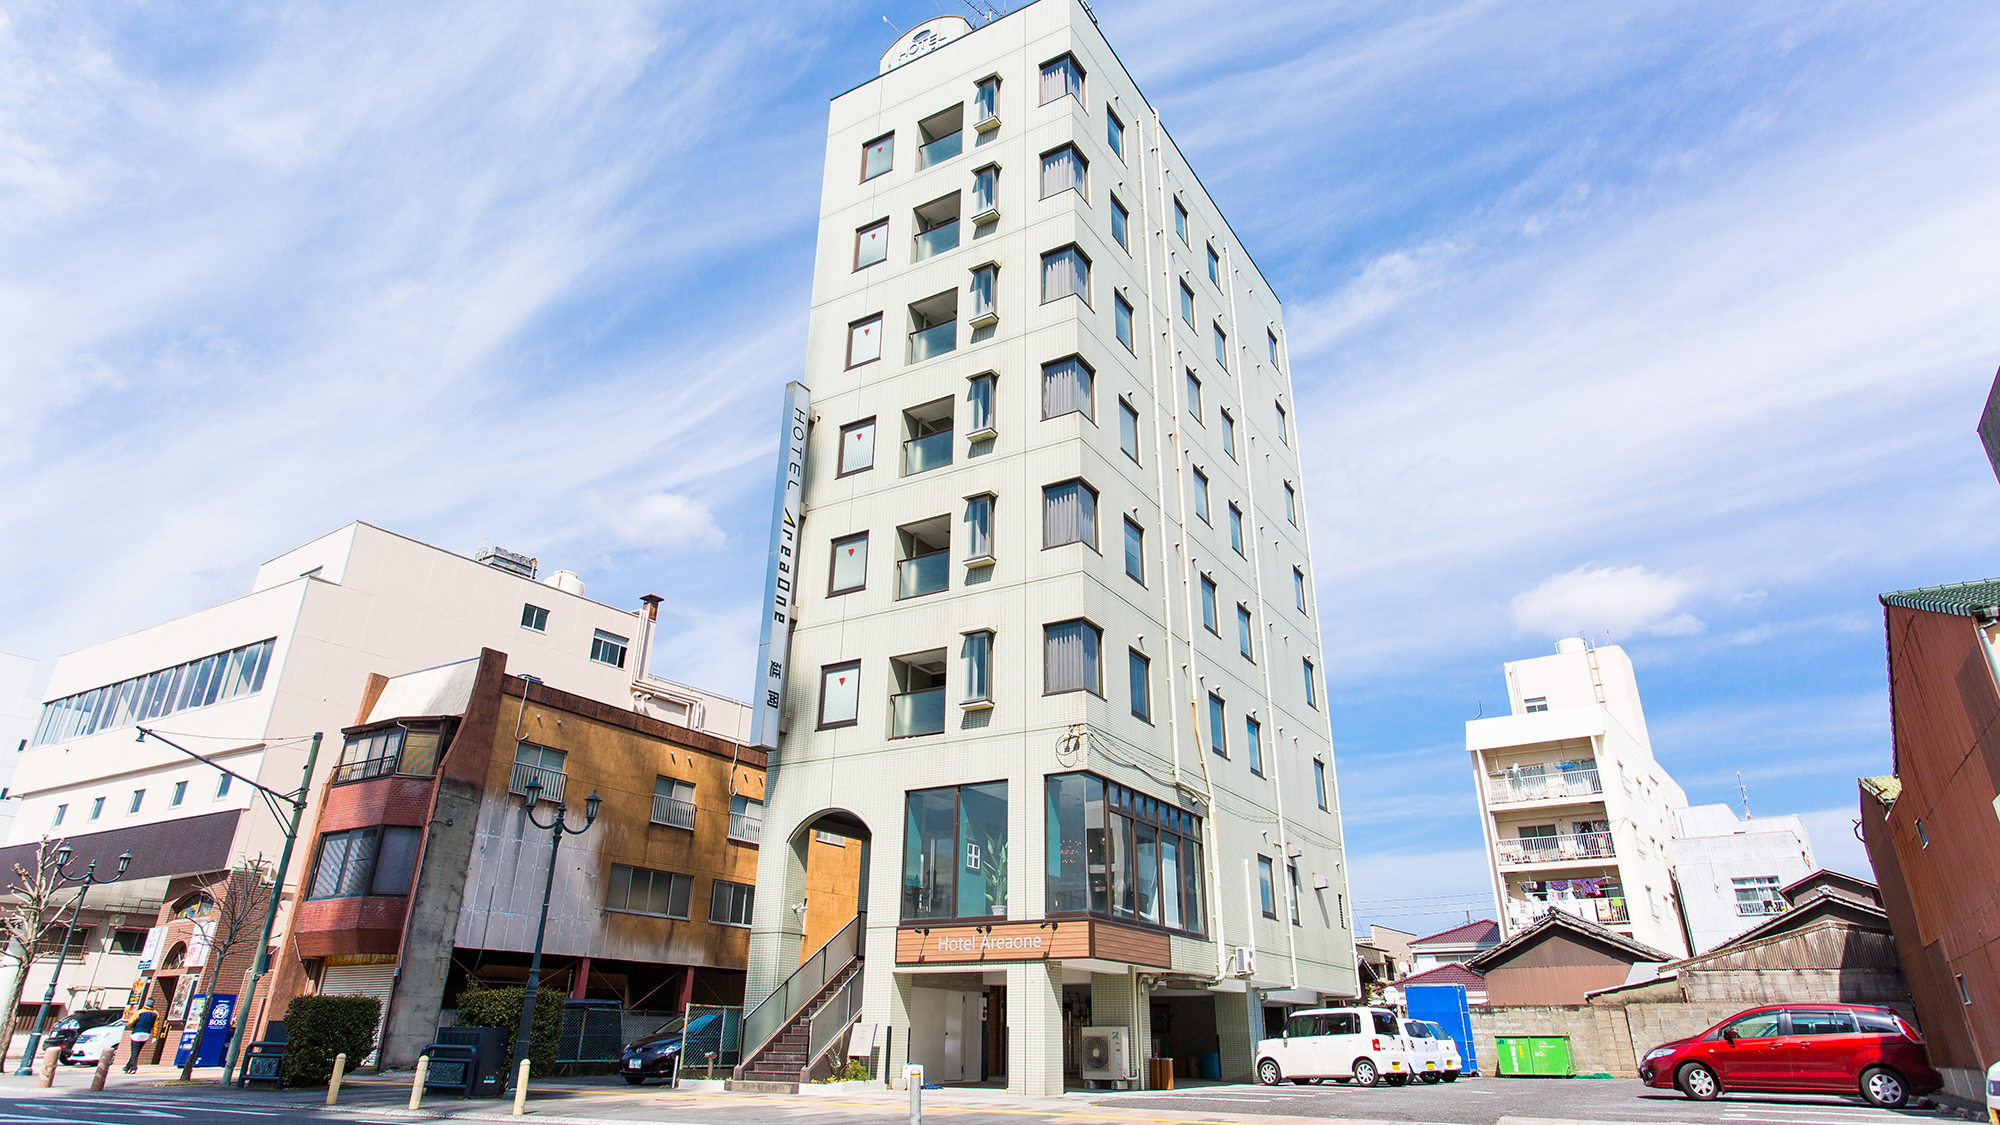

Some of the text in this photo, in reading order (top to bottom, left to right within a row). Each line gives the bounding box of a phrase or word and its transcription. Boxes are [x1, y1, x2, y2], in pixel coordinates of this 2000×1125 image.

[898, 31, 947, 61] HOTEL
[787, 407, 806, 490] HOTEL
[766, 660, 782, 709] 延岡
[938, 934, 1042, 952] Hotel Areaone
[208, 1018, 227, 1026] BOSS
